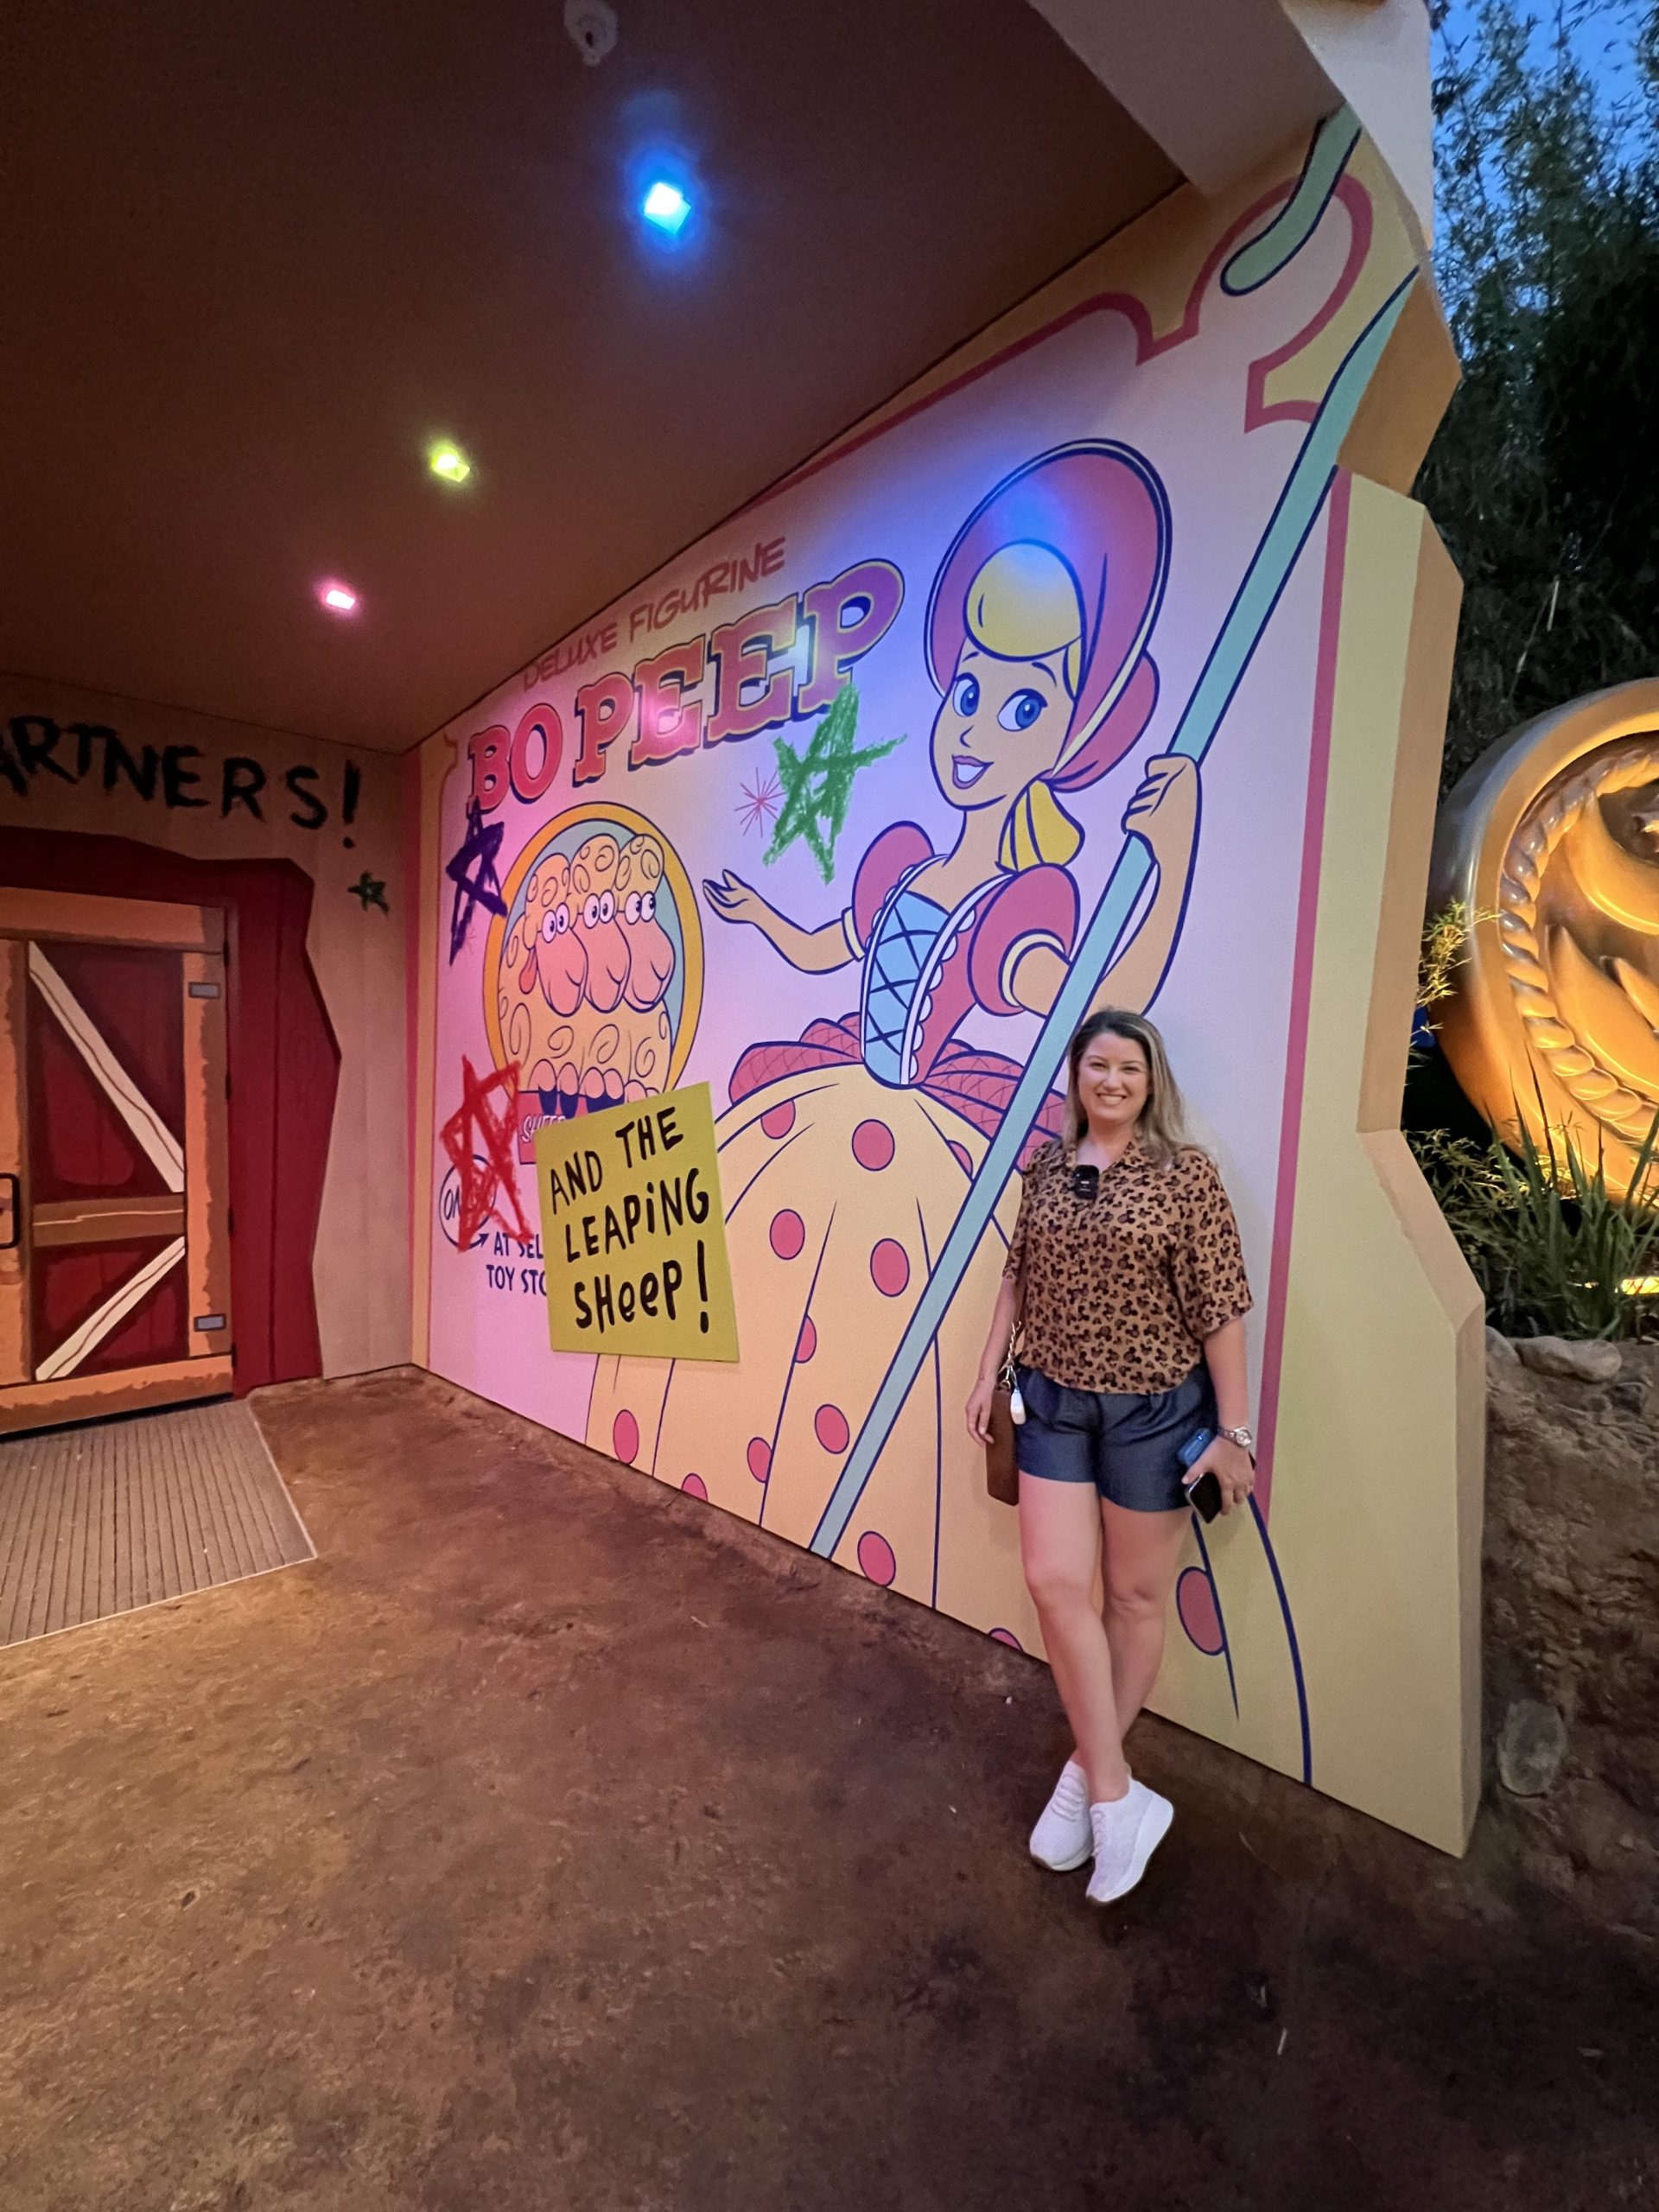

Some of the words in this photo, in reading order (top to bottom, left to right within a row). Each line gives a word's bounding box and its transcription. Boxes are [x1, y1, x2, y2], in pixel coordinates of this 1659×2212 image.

[523, 623, 618, 692] DELUXE
[628, 535, 785, 643] FIGURINE
[466, 702, 563, 817] BO
[571, 558, 906, 788] PEEP
[550, 1150, 602, 1215] AND
[615, 1106, 683, 1168] THE
[486, 1264, 515, 1292] TOY
[493, 1231, 512, 1257] AT
